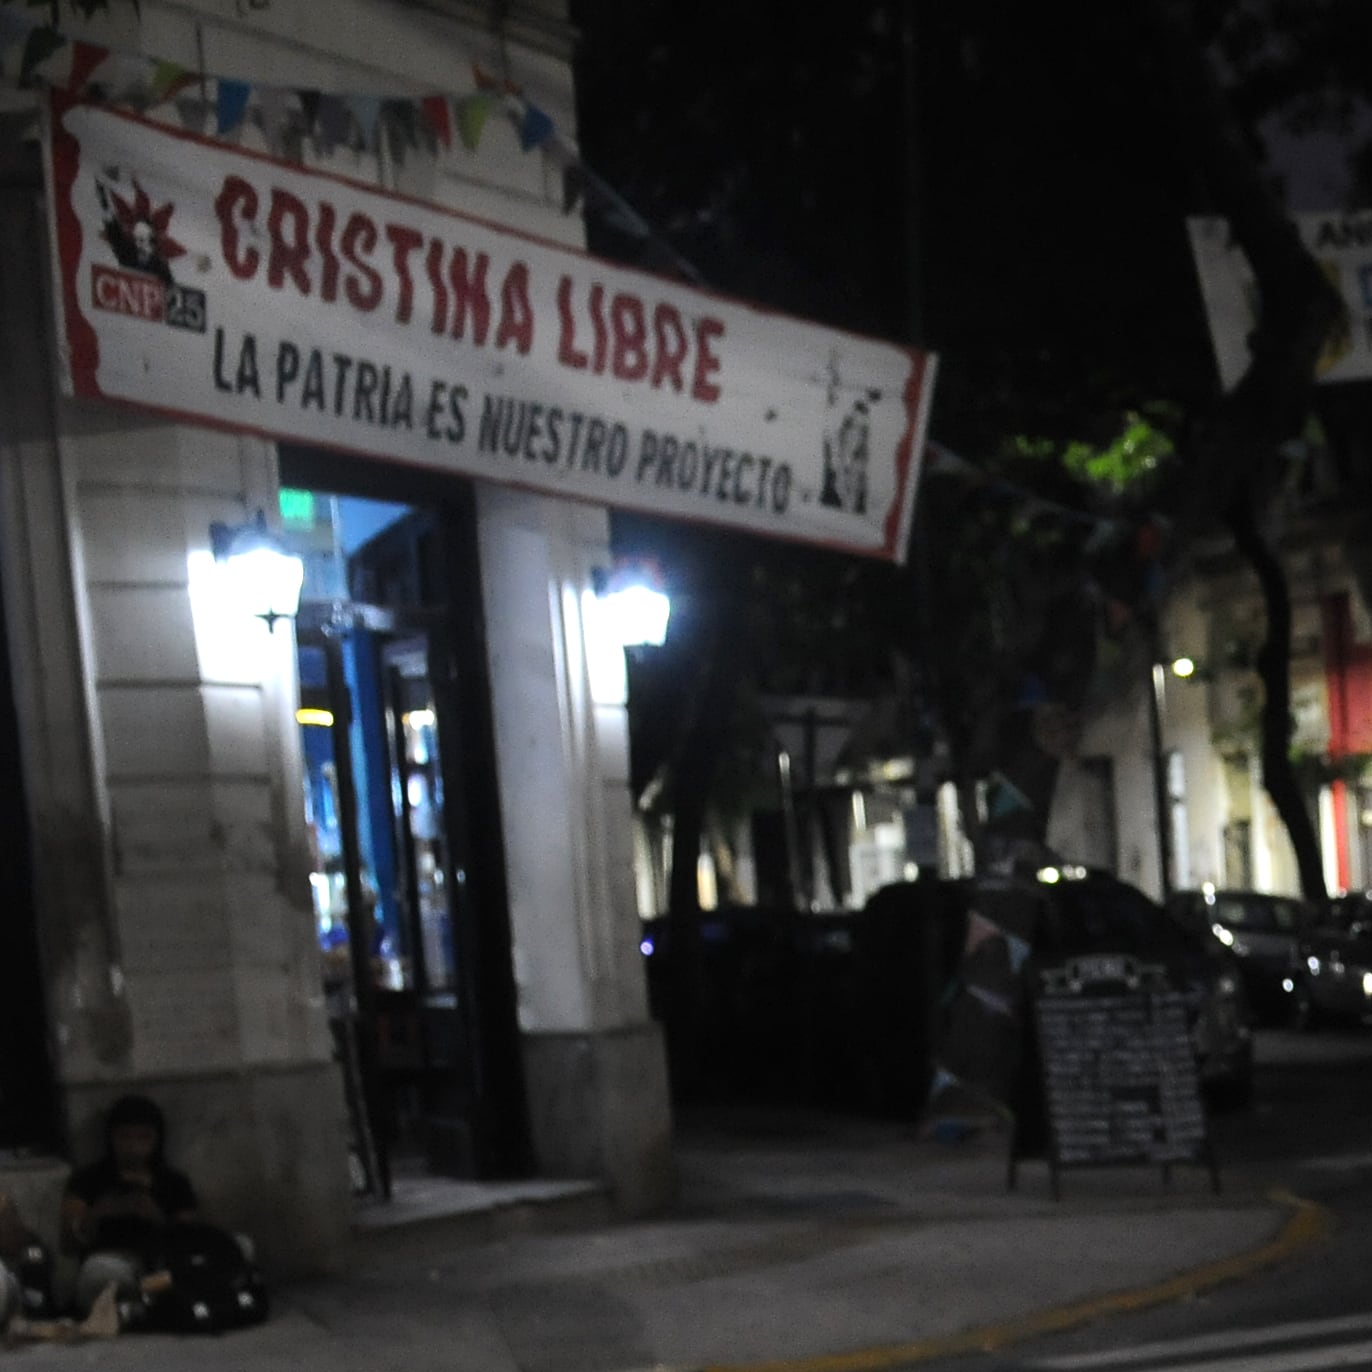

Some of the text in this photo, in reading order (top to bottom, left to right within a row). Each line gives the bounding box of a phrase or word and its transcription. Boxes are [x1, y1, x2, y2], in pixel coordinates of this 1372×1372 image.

[96, 273, 162, 317] CNP
[214, 175, 729, 403] CRISTINA LIBRE
[214, 328, 794, 514] LA PATRIA ES NUESTRO PROYECTO
